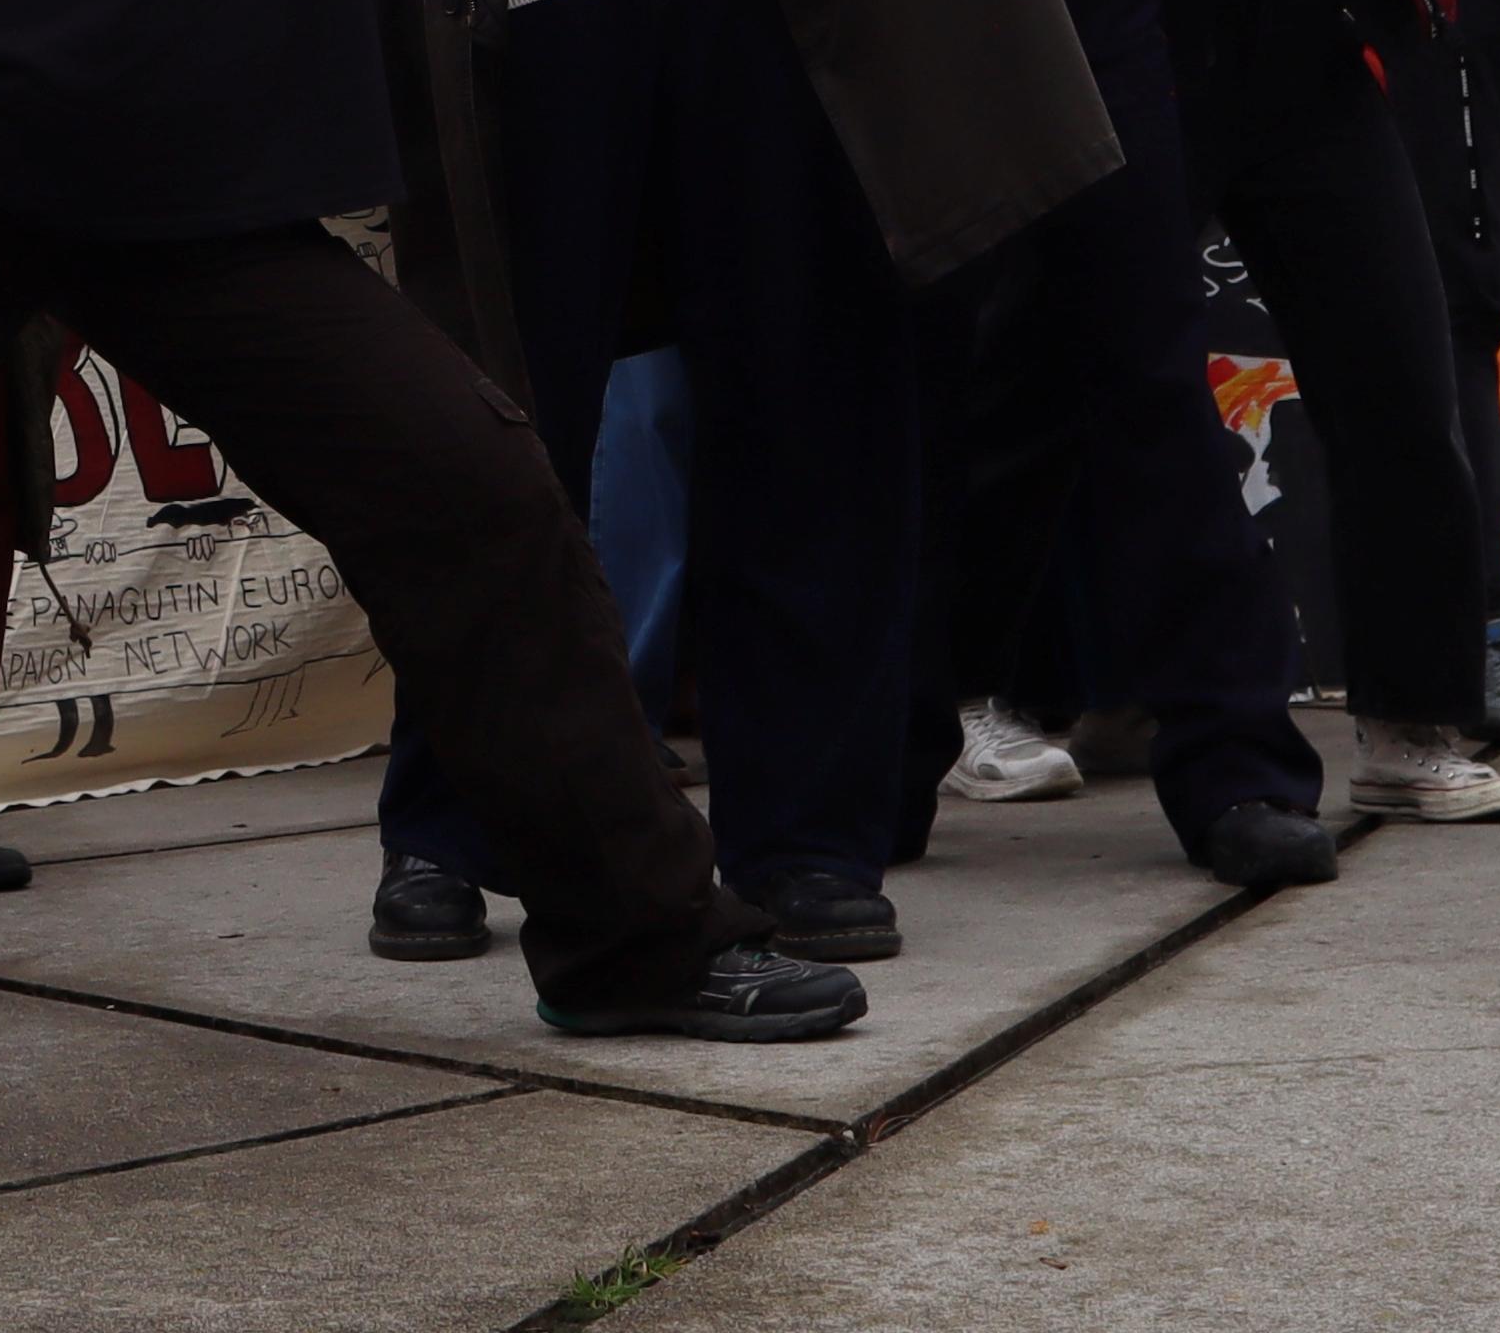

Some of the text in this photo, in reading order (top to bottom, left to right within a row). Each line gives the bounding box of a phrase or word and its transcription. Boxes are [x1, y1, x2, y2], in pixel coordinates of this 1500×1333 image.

[31, 581, 220, 627] PANAGUTIN
[241, 565, 349, 608] EURO
[1, 620, 293, 691] PAIGN NETWORK
